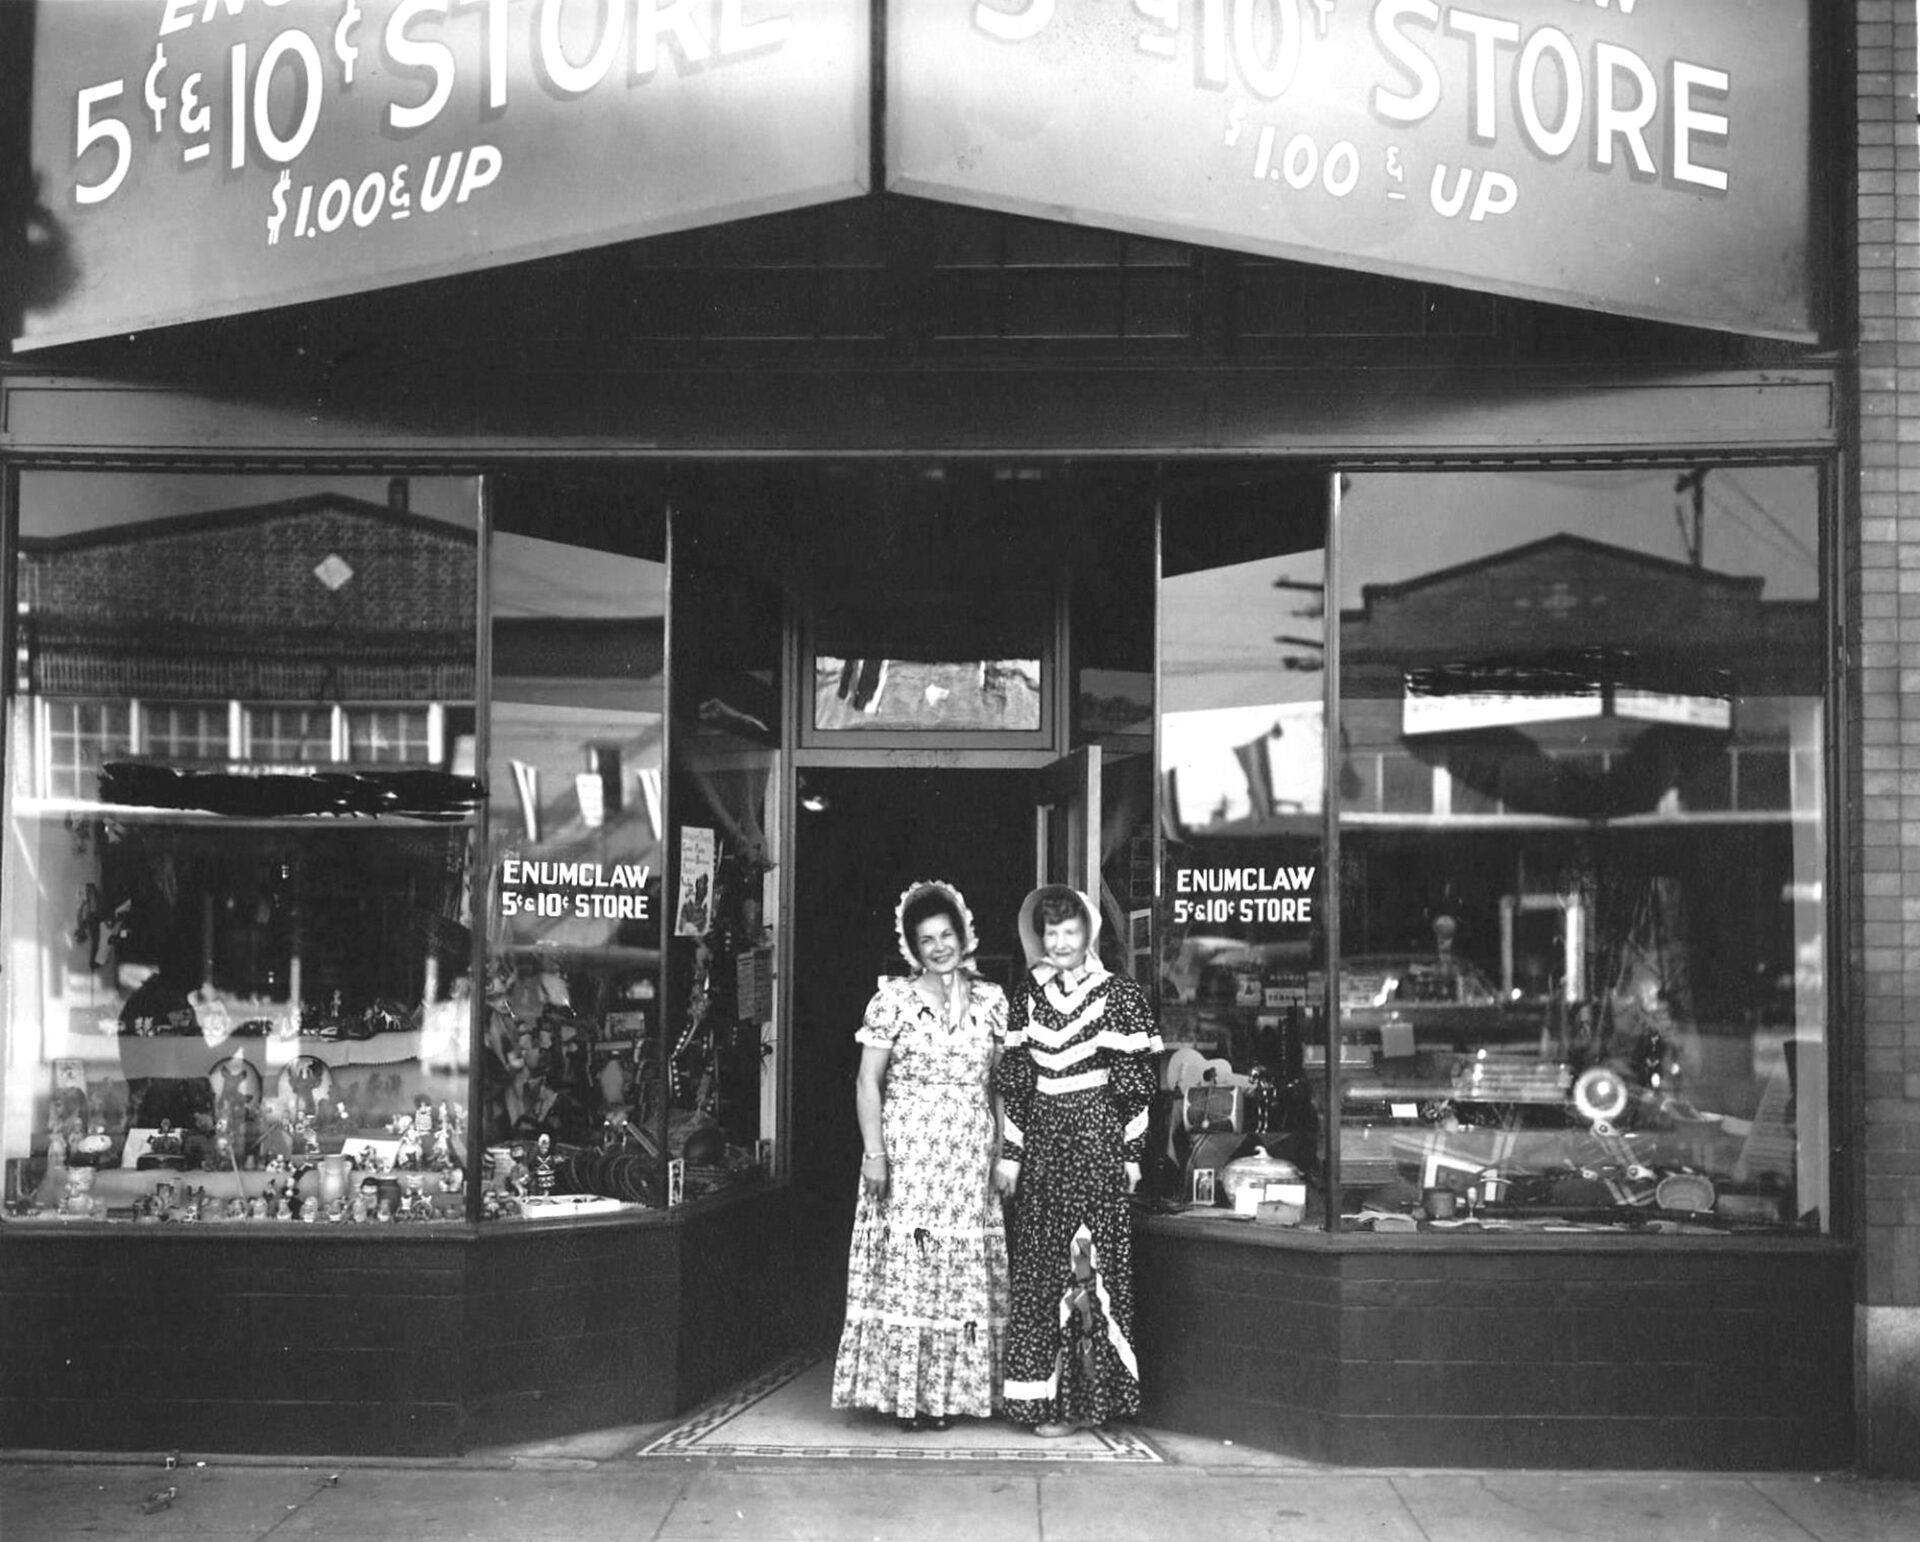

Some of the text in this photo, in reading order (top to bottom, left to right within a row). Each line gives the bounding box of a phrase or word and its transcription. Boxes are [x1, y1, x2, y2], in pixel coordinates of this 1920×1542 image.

[1375, 0, 1729, 190] STORE
[420, 145, 503, 213] UP
[1386, 146, 1406, 200] &
[1430, 163, 1519, 222] UP
[503, 859, 650, 889] ENUMCLAW
[1176, 866, 1316, 893] ENUMCLAW
[575, 893, 650, 920] STORE
[1239, 897, 1312, 923] STORE
